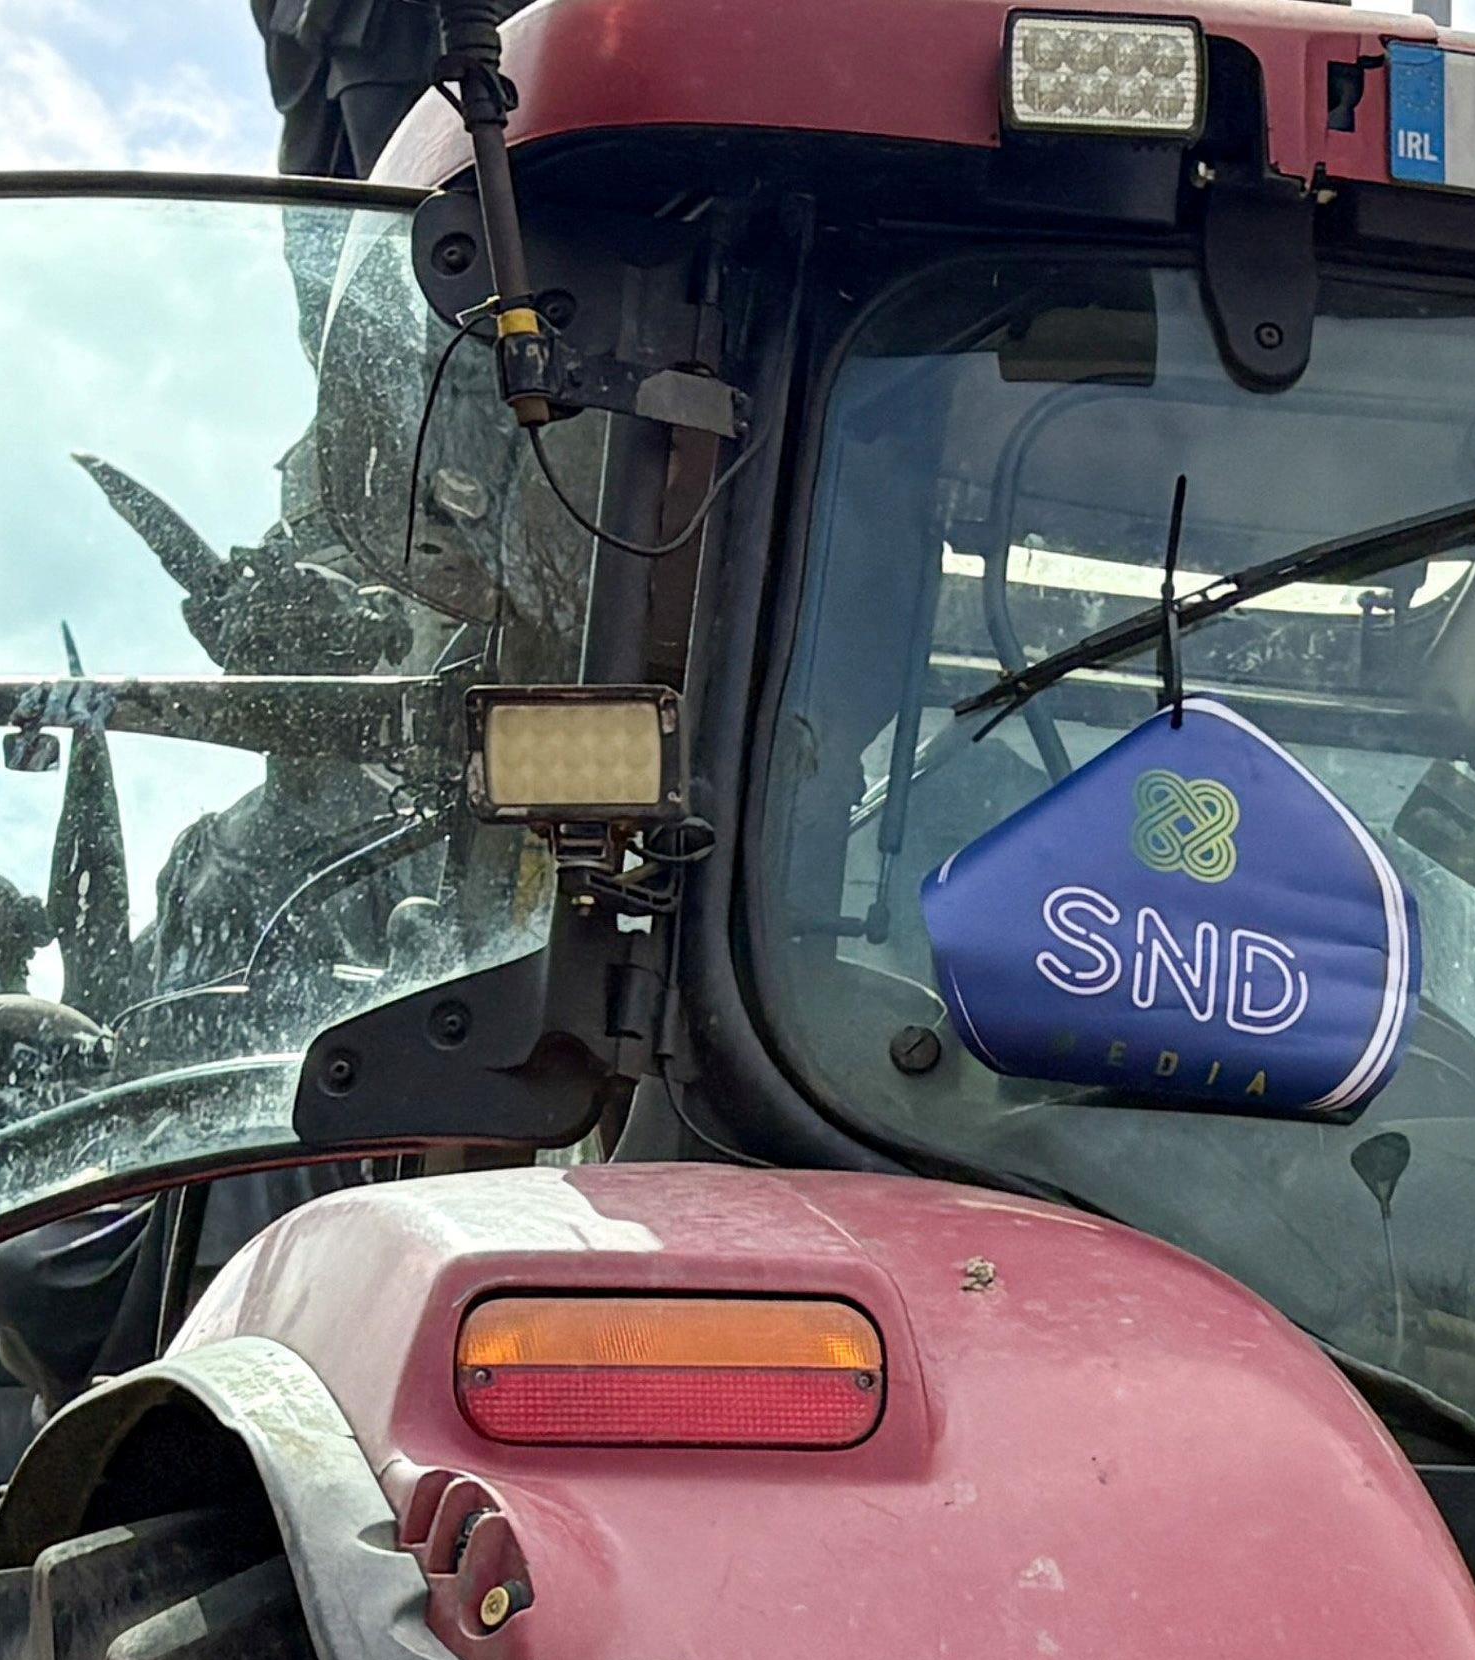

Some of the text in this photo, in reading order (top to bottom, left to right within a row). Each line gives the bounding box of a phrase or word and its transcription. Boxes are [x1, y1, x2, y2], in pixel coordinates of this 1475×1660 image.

[1397, 128, 1440, 163] IRL
[1035, 886, 1310, 1036] SND
[1052, 1030, 1267, 1096] EDIA
